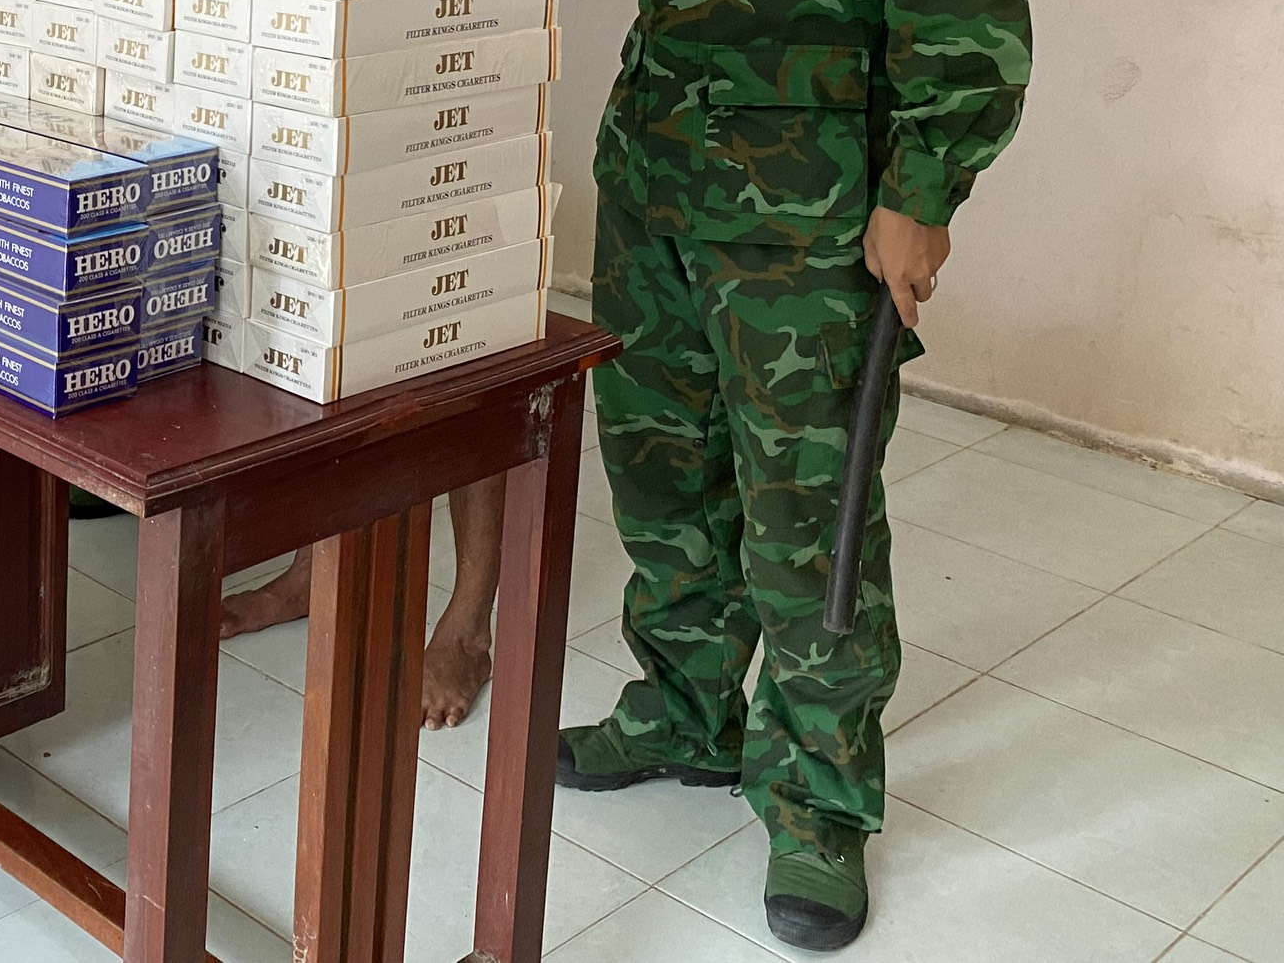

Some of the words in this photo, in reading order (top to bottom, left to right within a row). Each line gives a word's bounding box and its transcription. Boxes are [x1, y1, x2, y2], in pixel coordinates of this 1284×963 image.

[271, 12, 311, 34] JET
[436, 50, 474, 75] JET
[270, 69, 311, 94] JET
[434, 105, 469, 131] JET
[150, 162, 211, 193] HERO
[429, 161, 468, 187] JET
[12, 180, 34, 198] FINEST
[76, 182, 141, 214] HERO
[431, 213, 468, 241] JET
[154, 228, 213, 259] HERO
[74, 244, 141, 277] HERO
[431, 269, 469, 296] JET
[270, 291, 310, 318] JET
[402, 306, 428, 320] FILTER
[428, 299, 451, 313] KINGS
[451, 288, 494, 307] CIGARETTES
[67, 303, 135, 338] HERO
[423, 320, 462, 349] JET
[263, 346, 303, 376] JET
[64, 359, 132, 394] HERO
